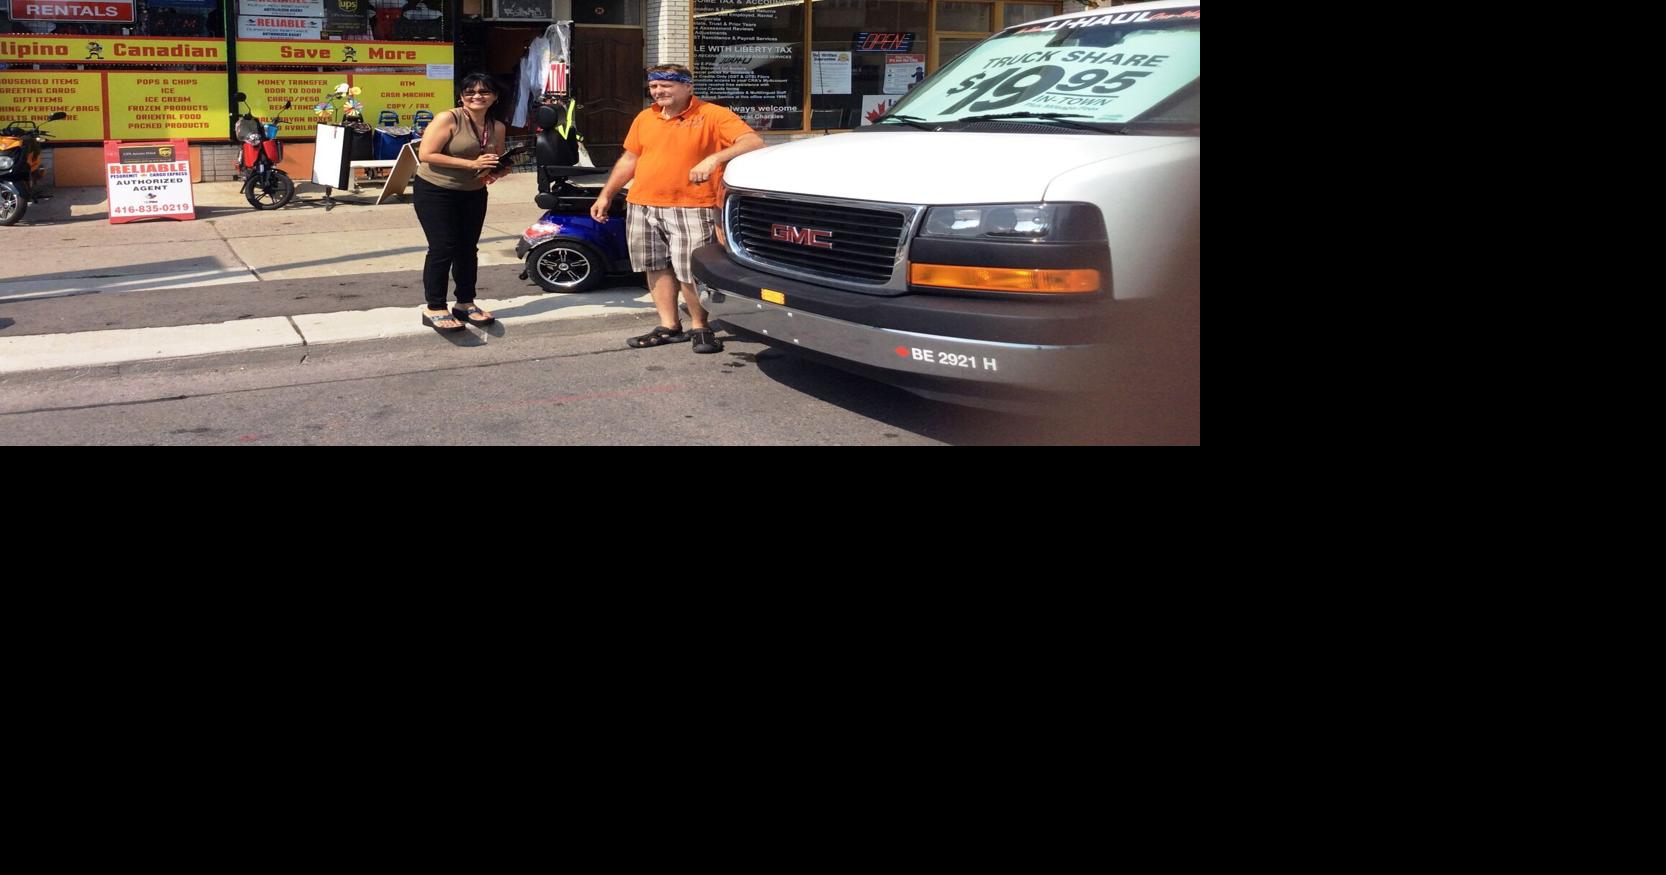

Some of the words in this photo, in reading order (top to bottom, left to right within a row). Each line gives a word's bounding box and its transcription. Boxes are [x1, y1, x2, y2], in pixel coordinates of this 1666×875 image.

[26, 4, 119, 17] RENTALS
[340, 1, 357, 10] ups
[256, 18, 306, 28] RELIABLE
[1041, 11, 1151, 32] U-HAUL
[862, 33, 906, 50] OPEN
[0, 41, 69, 58] lipino
[113, 43, 219, 58] Canadian
[280, 45, 331, 58] Save
[368, 47, 417, 60] More
[983, 50, 1061, 69] TRUCK
[1060, 50, 1170, 68] SHARE
[1032, 95, 1113, 106] IN-TOWN
[110, 163, 187, 174] RELIABLE
[116, 177, 184, 186] AUTHORIZED
[114, 203, 190, 214] 416-835-0219
[771, 223, 833, 250] GMC
[911, 347, 935, 363] BE
[938, 352, 977, 369] 2921
[982, 357, 998, 371] H
